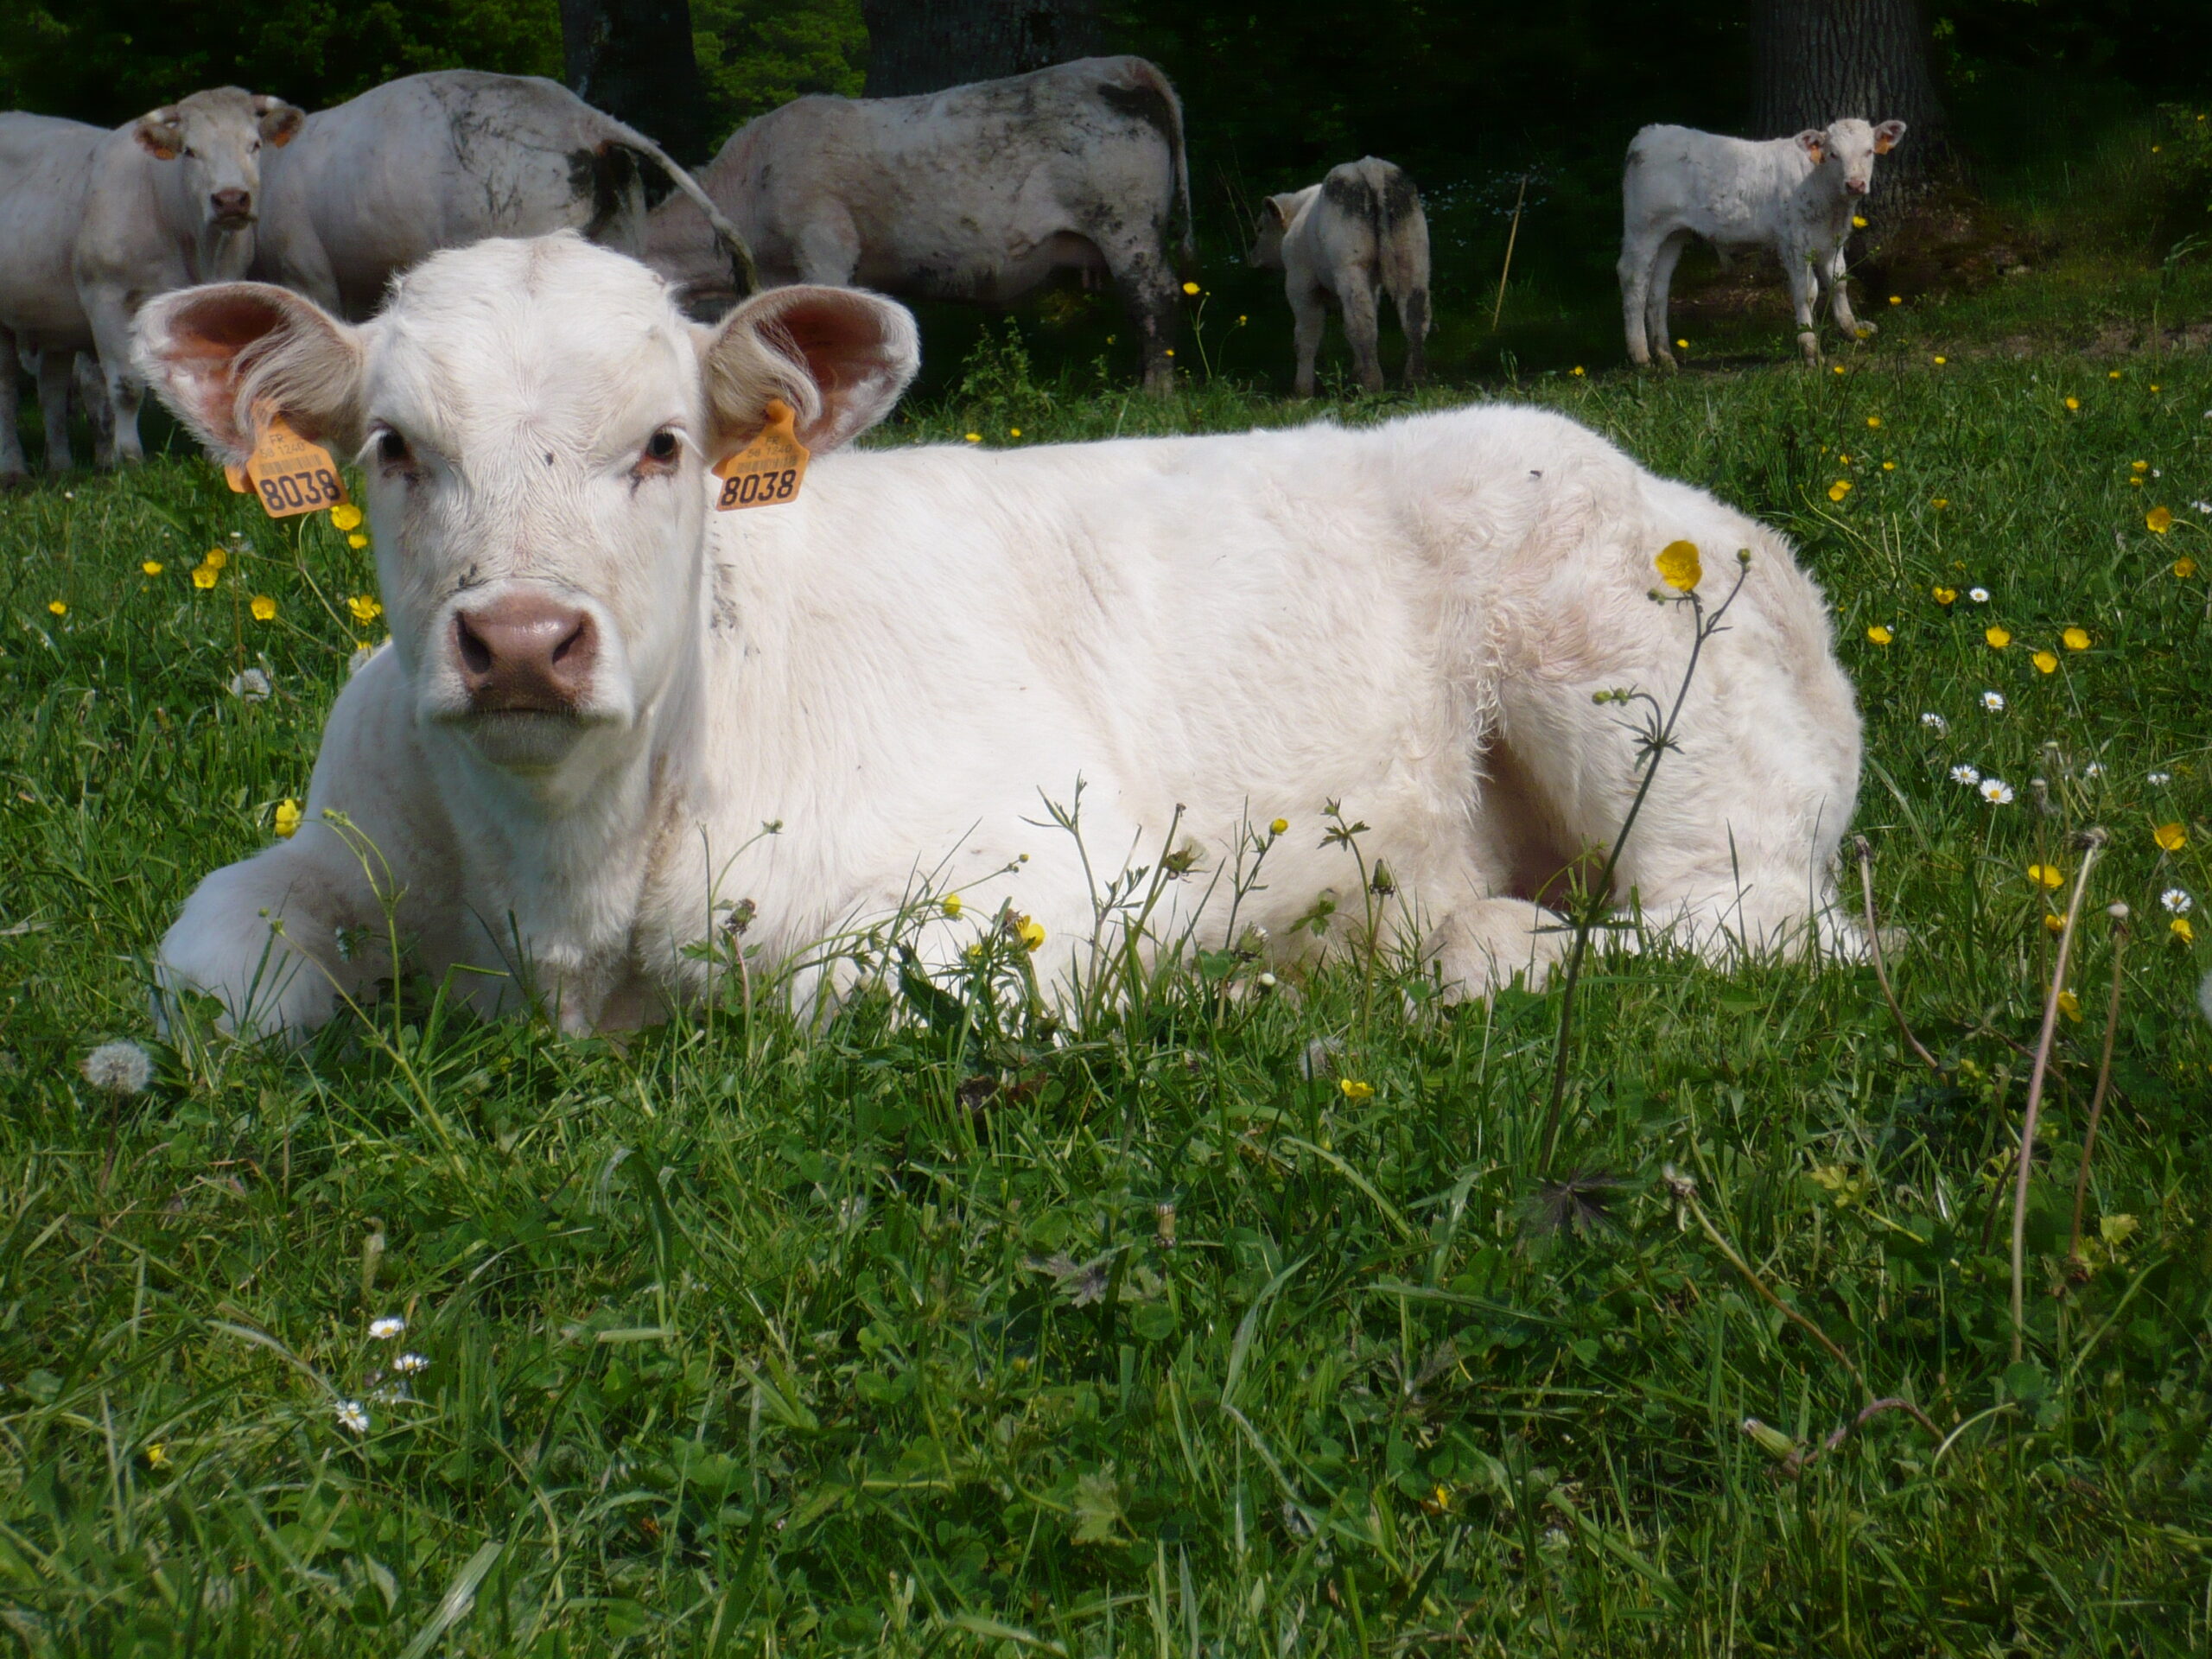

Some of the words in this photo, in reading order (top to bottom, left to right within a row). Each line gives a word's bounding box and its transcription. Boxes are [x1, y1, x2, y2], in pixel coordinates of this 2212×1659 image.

[269, 435, 284, 445] FR
[277, 442, 306, 456] 1240
[259, 468, 340, 512] 8038
[721, 469, 797, 506] 8038
